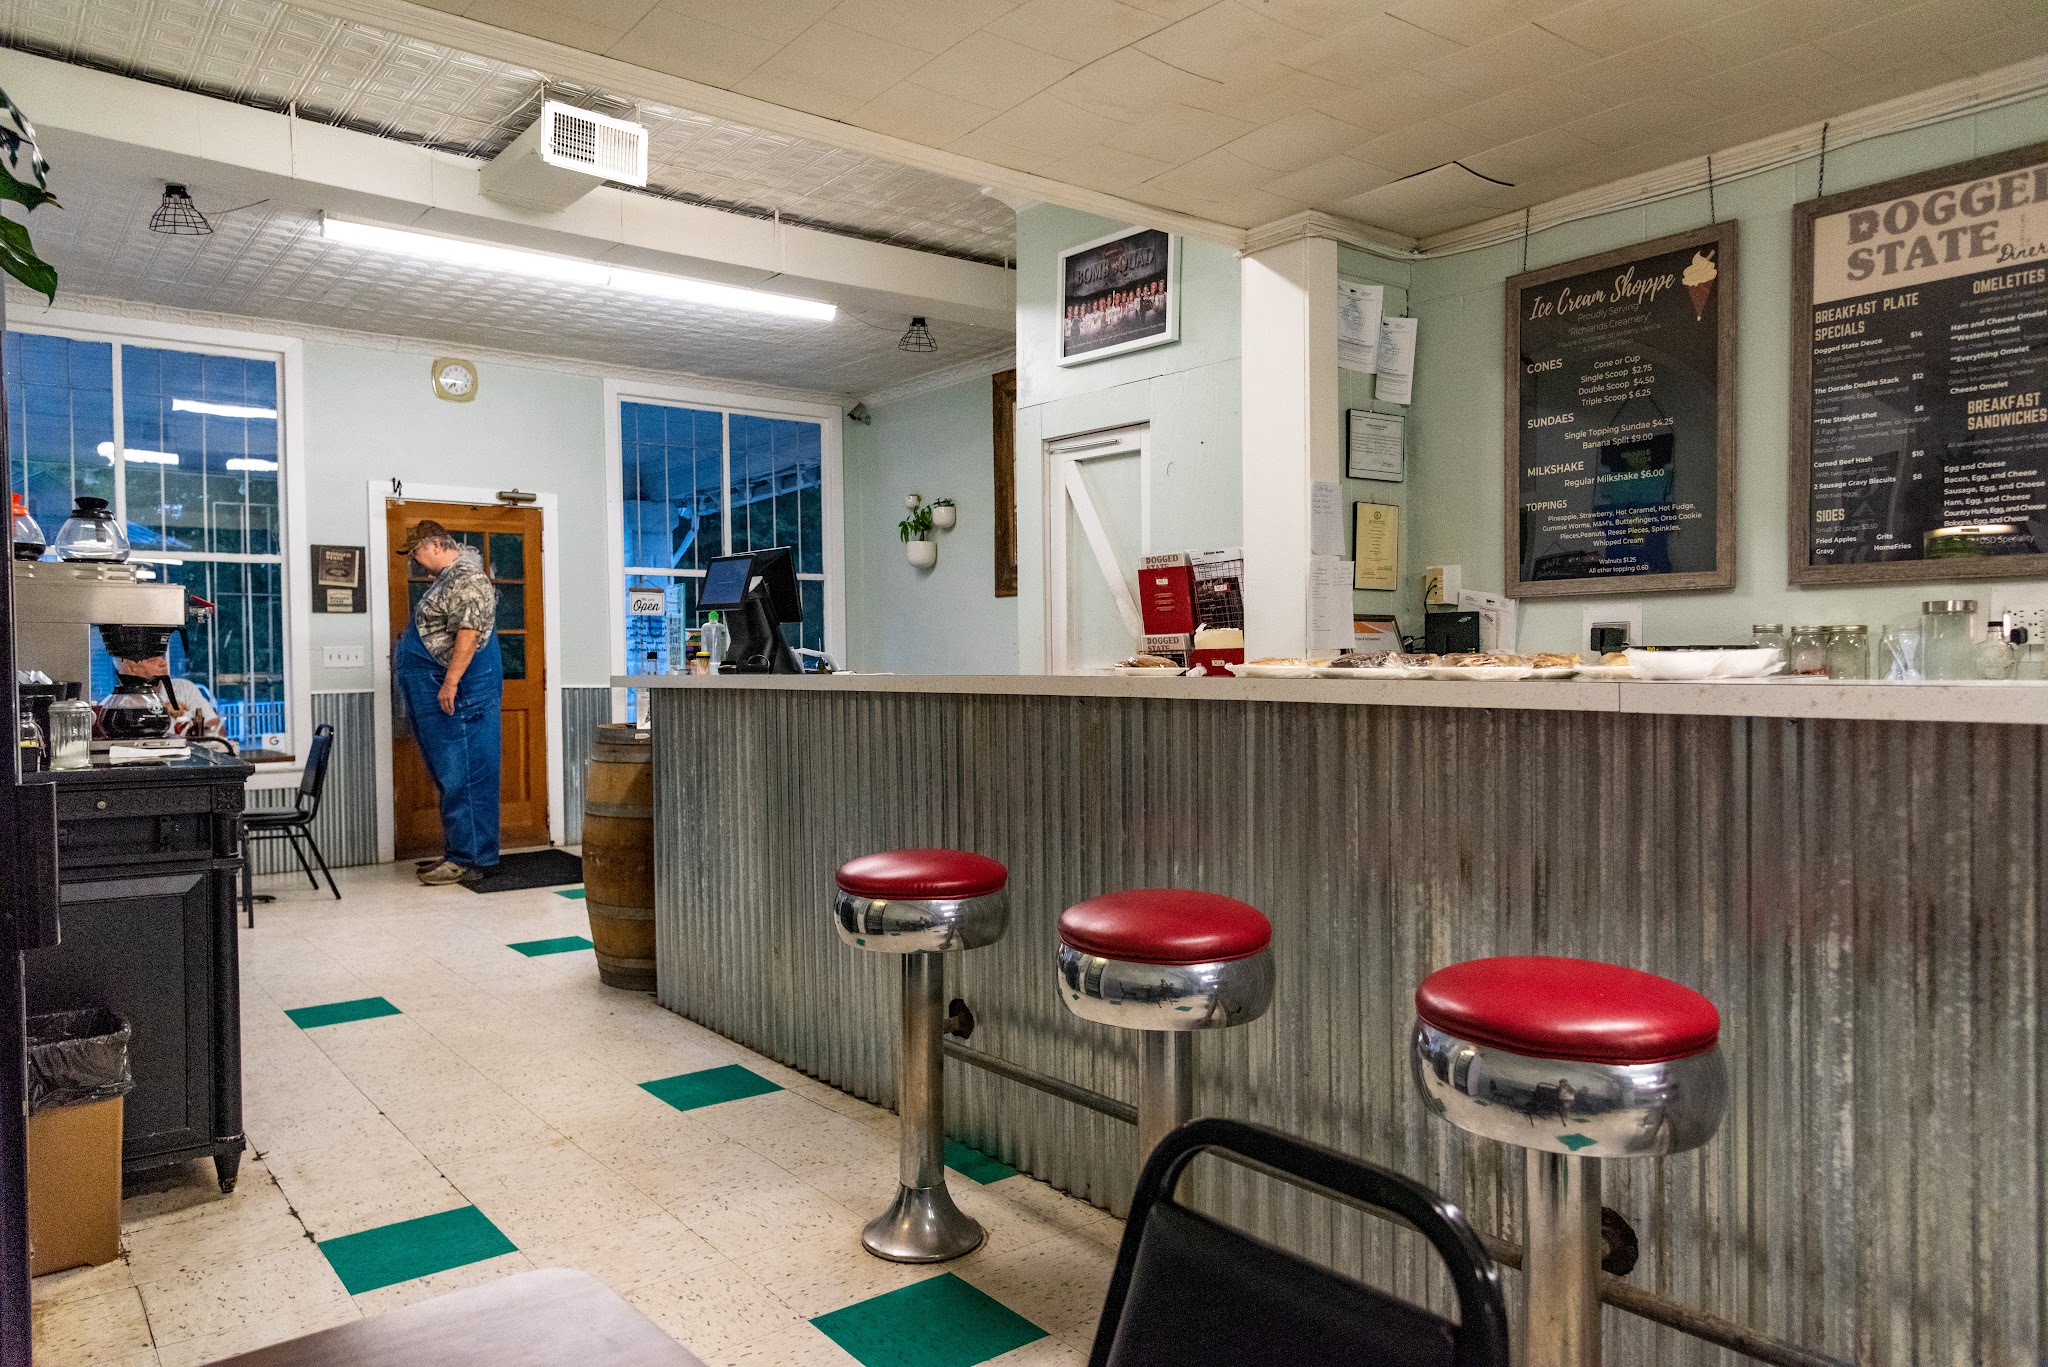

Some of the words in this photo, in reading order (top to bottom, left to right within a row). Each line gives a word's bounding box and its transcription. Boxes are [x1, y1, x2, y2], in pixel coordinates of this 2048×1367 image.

[1846, 220, 2000, 281] STATE
[1972, 268, 2046, 295] OMELETTES
[1529, 296, 1553, 321] Ice
[1557, 287, 1607, 316] Cream
[1610, 265, 1675, 304] Shoppe
[1577, 307, 1607, 322] Proudly
[1608, 303, 1639, 316] Serving
[1815, 300, 1877, 325] BREAKFAST
[1883, 292, 1919, 312] PLATE
[1951, 324, 1969, 332] Ham
[1970, 320, 1985, 329] and
[1986, 315, 2016, 326] Cheese
[2017, 309, 2048, 320] Omelet
[1814, 320, 1865, 341] SPECIALS
[1991, 325, 2020, 336] Omelet
[1814, 344, 1840, 355] Dogged
[1841, 341, 1859, 350] State
[1860, 338, 1883, 347] Deuce
[2000, 345, 2030, 355] Omelet
[1527, 358, 1563, 374] CONES
[1593, 360, 1614, 369] Cone
[1624, 354, 1640, 365] Cup
[1580, 373, 1603, 384] Single
[1605, 368, 1628, 380] Scoop
[1632, 363, 1652, 374] $2.75
[1578, 385, 1604, 396] Double
[1606, 381, 1630, 392] Scoop
[1633, 376, 1655, 386] $4.50
[1828, 384, 1852, 392] Dorado
[1854, 380, 1878, 389] Double
[1879, 377, 1900, 385] Stack
[1950, 386, 1978, 394] Cheese
[1979, 381, 2009, 390] Omelet
[1581, 396, 1602, 407] Triple
[1603, 393, 1627, 404] Scoop
[1628, 391, 1634, 399] $
[1635, 388, 1651, 398] 6.25
[1967, 392, 2041, 415] BREAKFAST
[1527, 412, 1575, 429] SUNDAES
[1833, 413, 1860, 424] Straight
[1861, 411, 1878, 419] Shot
[1967, 408, 2048, 431] SANDWICHES
[1564, 430, 1587, 440] Single
[1588, 427, 1620, 438] Topping
[1621, 421, 1651, 432] Sundae
[1652, 417, 1674, 428] $4.25
[1582, 439, 1611, 449] Banana
[1612, 435, 1630, 446] Split
[1631, 432, 1653, 443] $9.00
[1527, 461, 1585, 477] MILKSHAKE
[1944, 465, 1959, 473] Egg
[1960, 463, 1976, 471] and
[1977, 461, 2006, 469] Cheese
[1564, 477, 1596, 488] Regular
[1596, 472, 1639, 483] Milkshake
[1640, 468, 1665, 479] $6.00
[1819, 481, 1847, 489] Sausage
[1848, 479, 1868, 487] Gravy
[1868, 476, 1897, 485] Biscuits
[1944, 476, 1970, 484] Bacon,
[1990, 472, 2006, 480] and
[2007, 470, 2037, 478] Cheese
[1944, 487, 1978, 496] Sausage,
[1998, 483, 2014, 491] and
[2015, 480, 2046, 489] Cheese
[1984, 495, 2000, 503] and
[2001, 493, 2031, 502] Cheese
[1526, 500, 1568, 512] TOPPINGS
[1548, 513, 1579, 523] Pineapple,
[1579, 509, 1615, 520] Strawberry,
[1615, 508, 1627, 516] Hot
[1628, 506, 1658, 515] Caramel,
[1658, 504, 1671, 512] Hot
[1672, 502, 1696, 511] Fudge,
[1944, 509, 1970, 518] Country
[2020, 503, 2047, 511] Cheese
[1542, 523, 1567, 532] Gummie
[1568, 521, 1592, 530] Worms,
[1615, 515, 1659, 527] Butterfingers,
[1660, 513, 1677, 522] Oreo
[1678, 511, 1702, 520] Cookie
[1816, 508, 1845, 523] SIDES
[1989, 516, 2003, 524] and
[2003, 514, 2030, 523] Cheese
[1607, 528, 1627, 536] Reese
[1627, 526, 1650, 534] Pieces,
[1833, 535, 1857, 544] Apples
[1876, 532, 1894, 540] Grits
[1593, 538, 1622, 547] Whipped
[1622, 537, 1644, 545] Cream
[1979, 536, 1996, 545] DSD
[1816, 548, 1835, 556] Gravy
[1873, 543, 1912, 551] HomeFries
[1146, 554, 1179, 564] DOGGED
[1598, 557, 1623, 565] Walnuts
[1623, 556, 1637, 564] $1.25
[1597, 566, 1612, 574] other
[1612, 565, 1636, 574] topping
[1636, 564, 1649, 572] 0.60
[633, 599, 661, 613] Open
[1146, 636, 1180, 645] DOGGED
